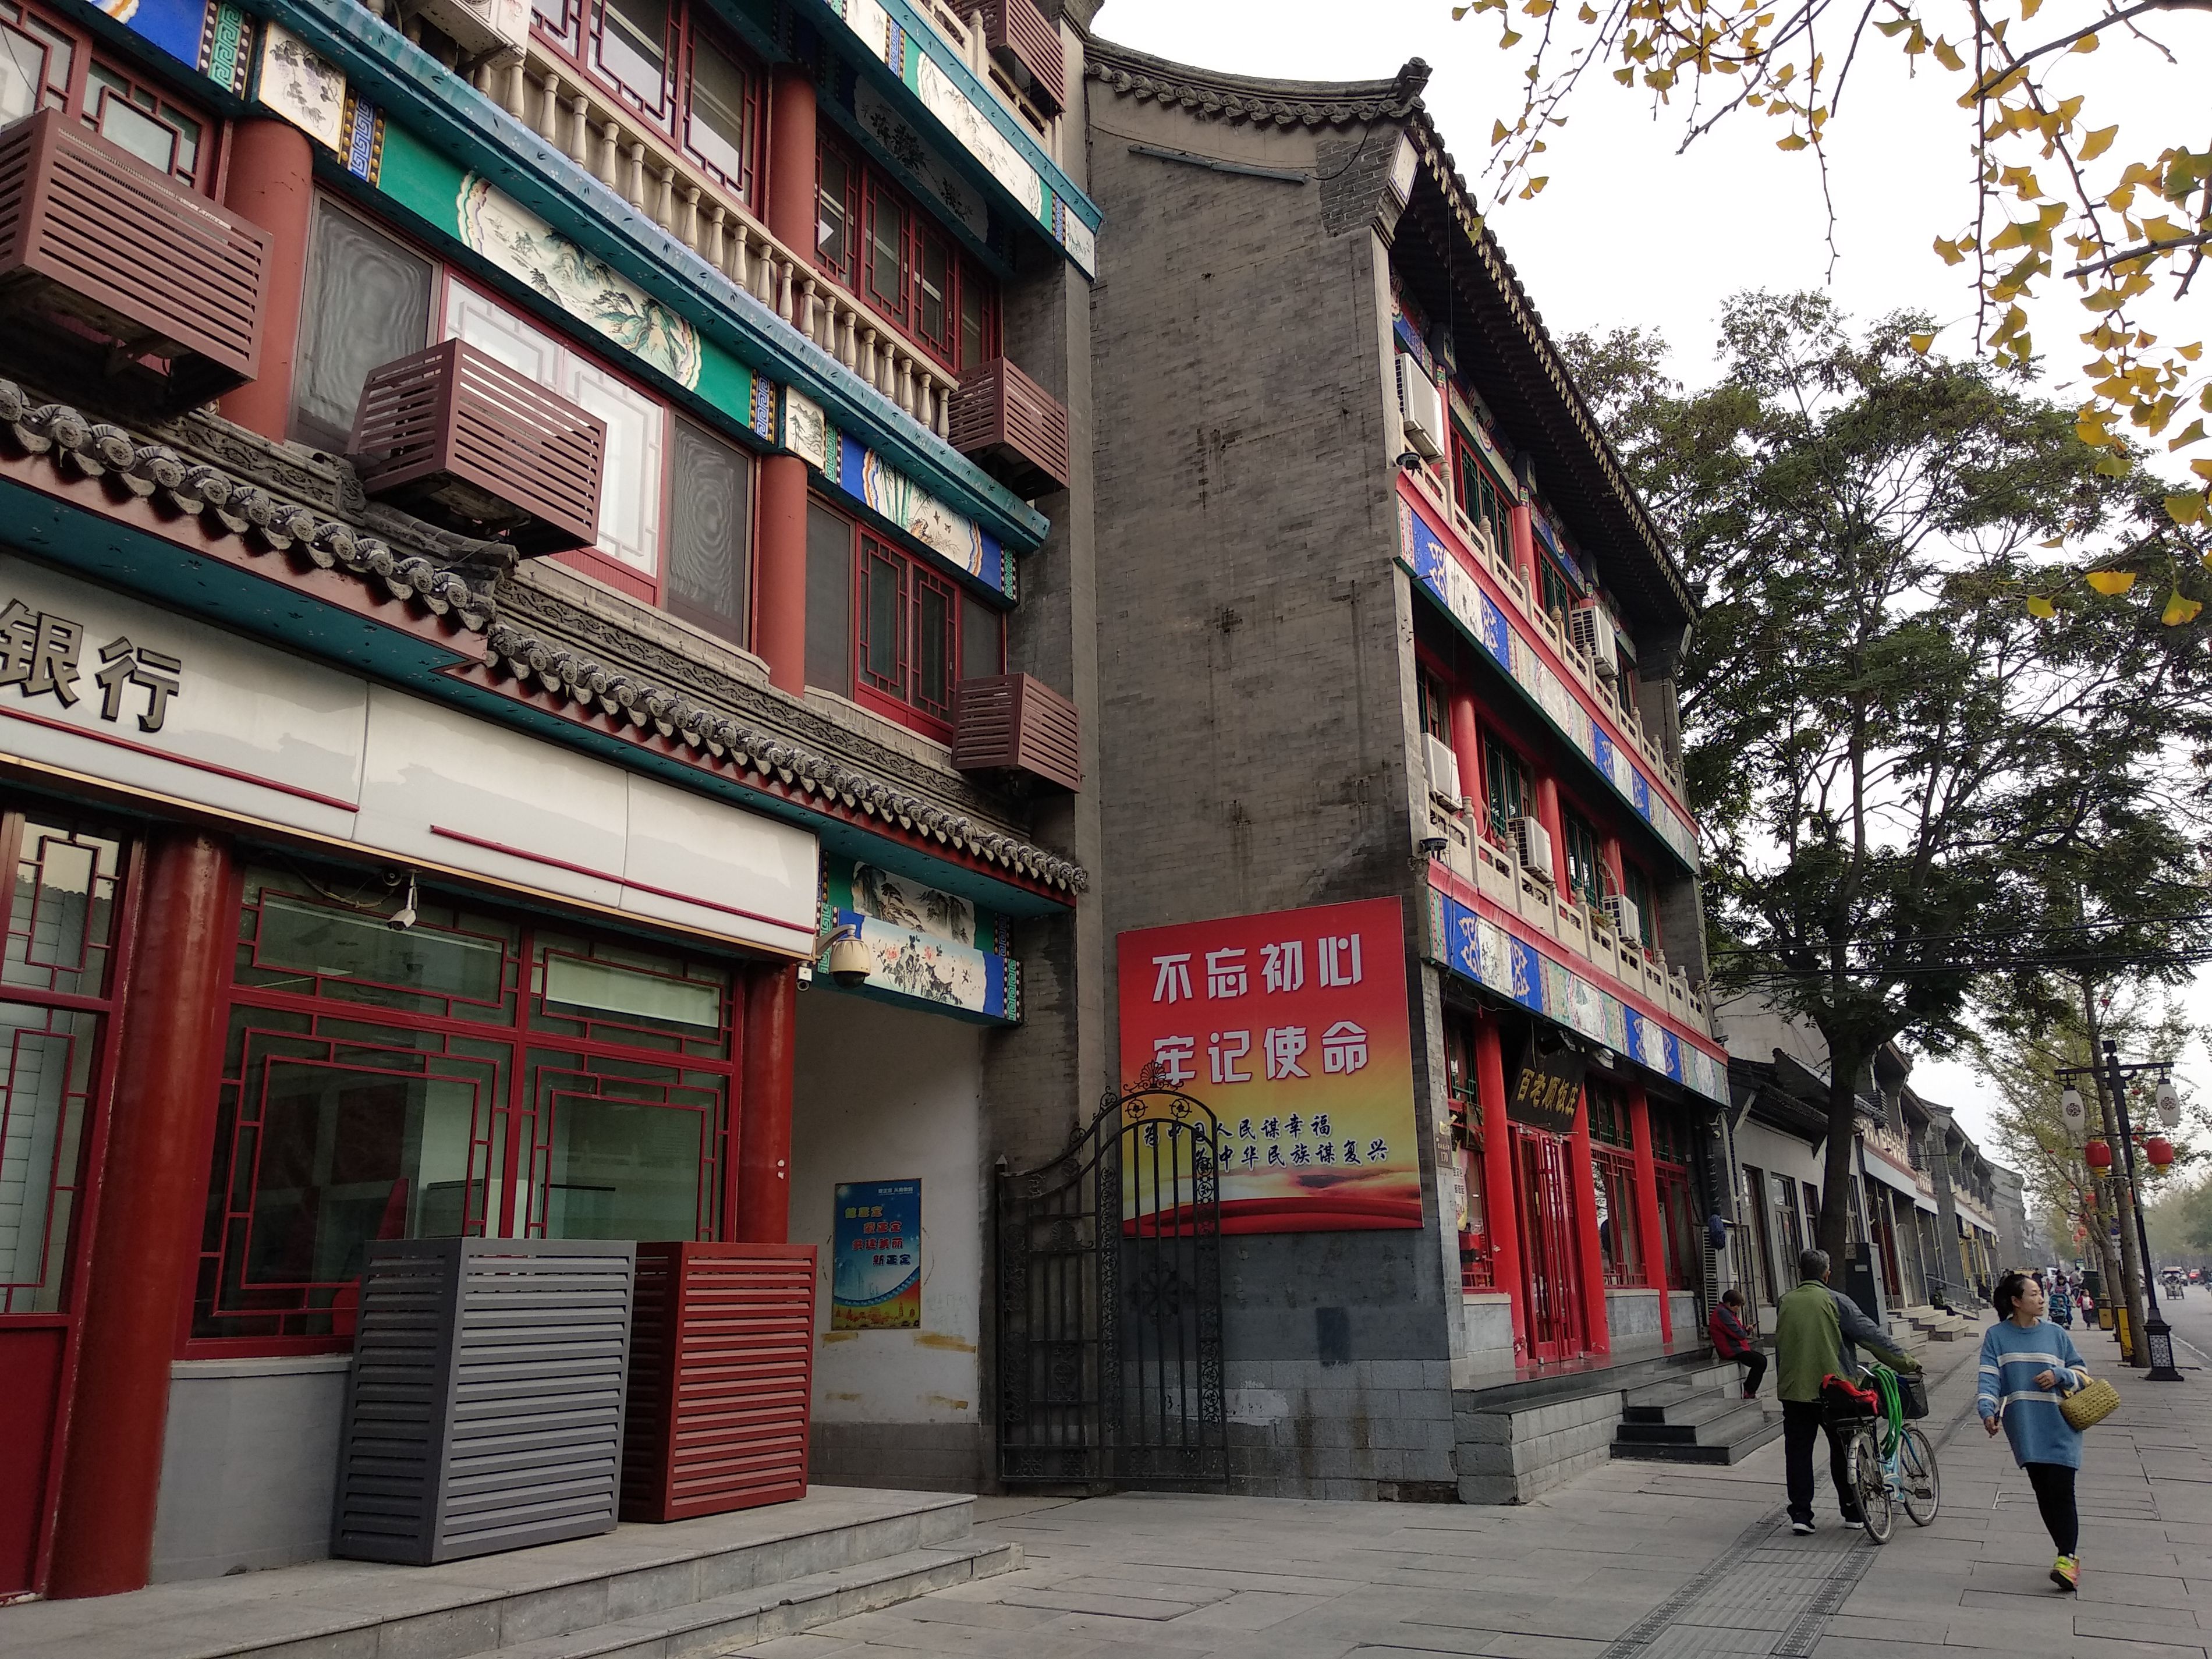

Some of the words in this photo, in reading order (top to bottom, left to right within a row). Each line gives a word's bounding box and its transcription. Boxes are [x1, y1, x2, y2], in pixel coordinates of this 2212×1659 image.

[1151, 933, 1362, 1004] 不忘初心
[1153, 1020, 1369, 1086] 牢记使命
[873, 1253, 912, 1267] 新正定
